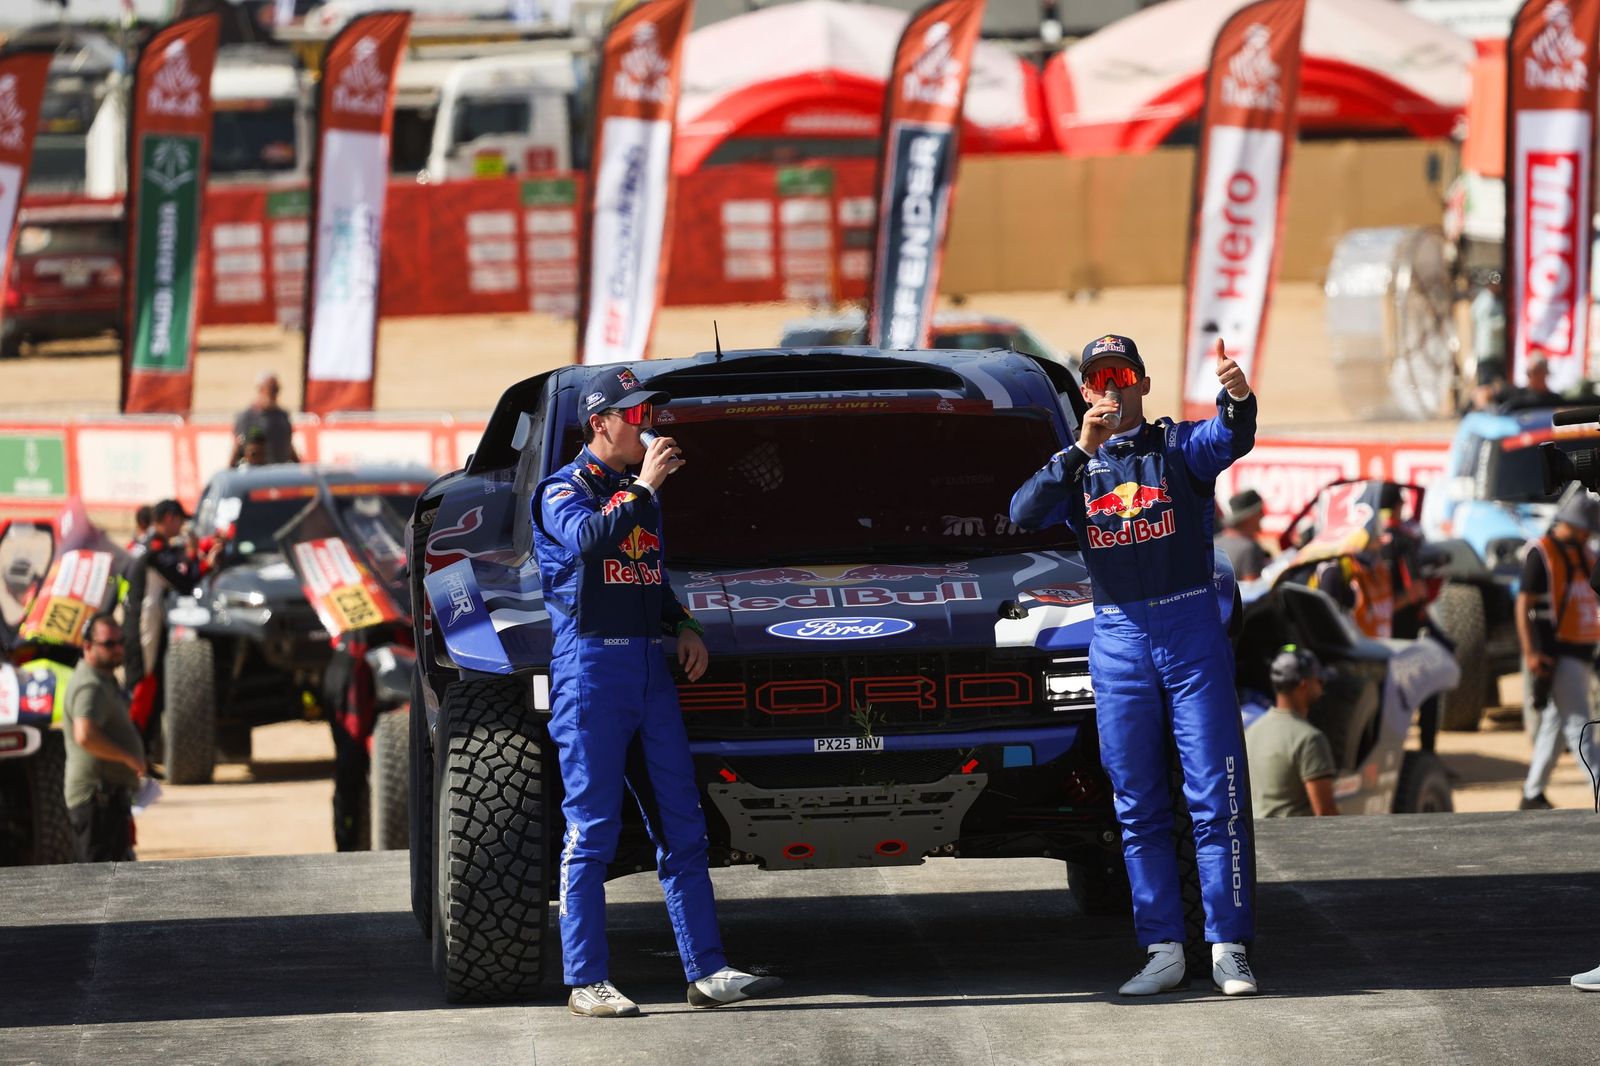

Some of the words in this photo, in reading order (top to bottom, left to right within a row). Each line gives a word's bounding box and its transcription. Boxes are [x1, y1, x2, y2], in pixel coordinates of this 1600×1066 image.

[889, 137, 940, 349] EFENDER
[1216, 170, 1258, 299] Hero
[1526, 157, 1574, 352] MOTUL
[725, 405, 783, 414] DREAM.
[787, 403, 832, 411] DARE.
[1086, 521, 1132, 548] Red
[1134, 509, 1176, 544] Bull
[604, 559, 641, 585] Red
[687, 587, 835, 612] Red
[840, 581, 983, 608] Bull
[603, 638, 629, 646] sparco
[796, 618, 884, 637] Ford
[817, 738, 851, 751] PX25
[855, 737, 880, 750] BNV
[1226, 755, 1239, 837] RACING
[1232, 838, 1242, 907] FORD
